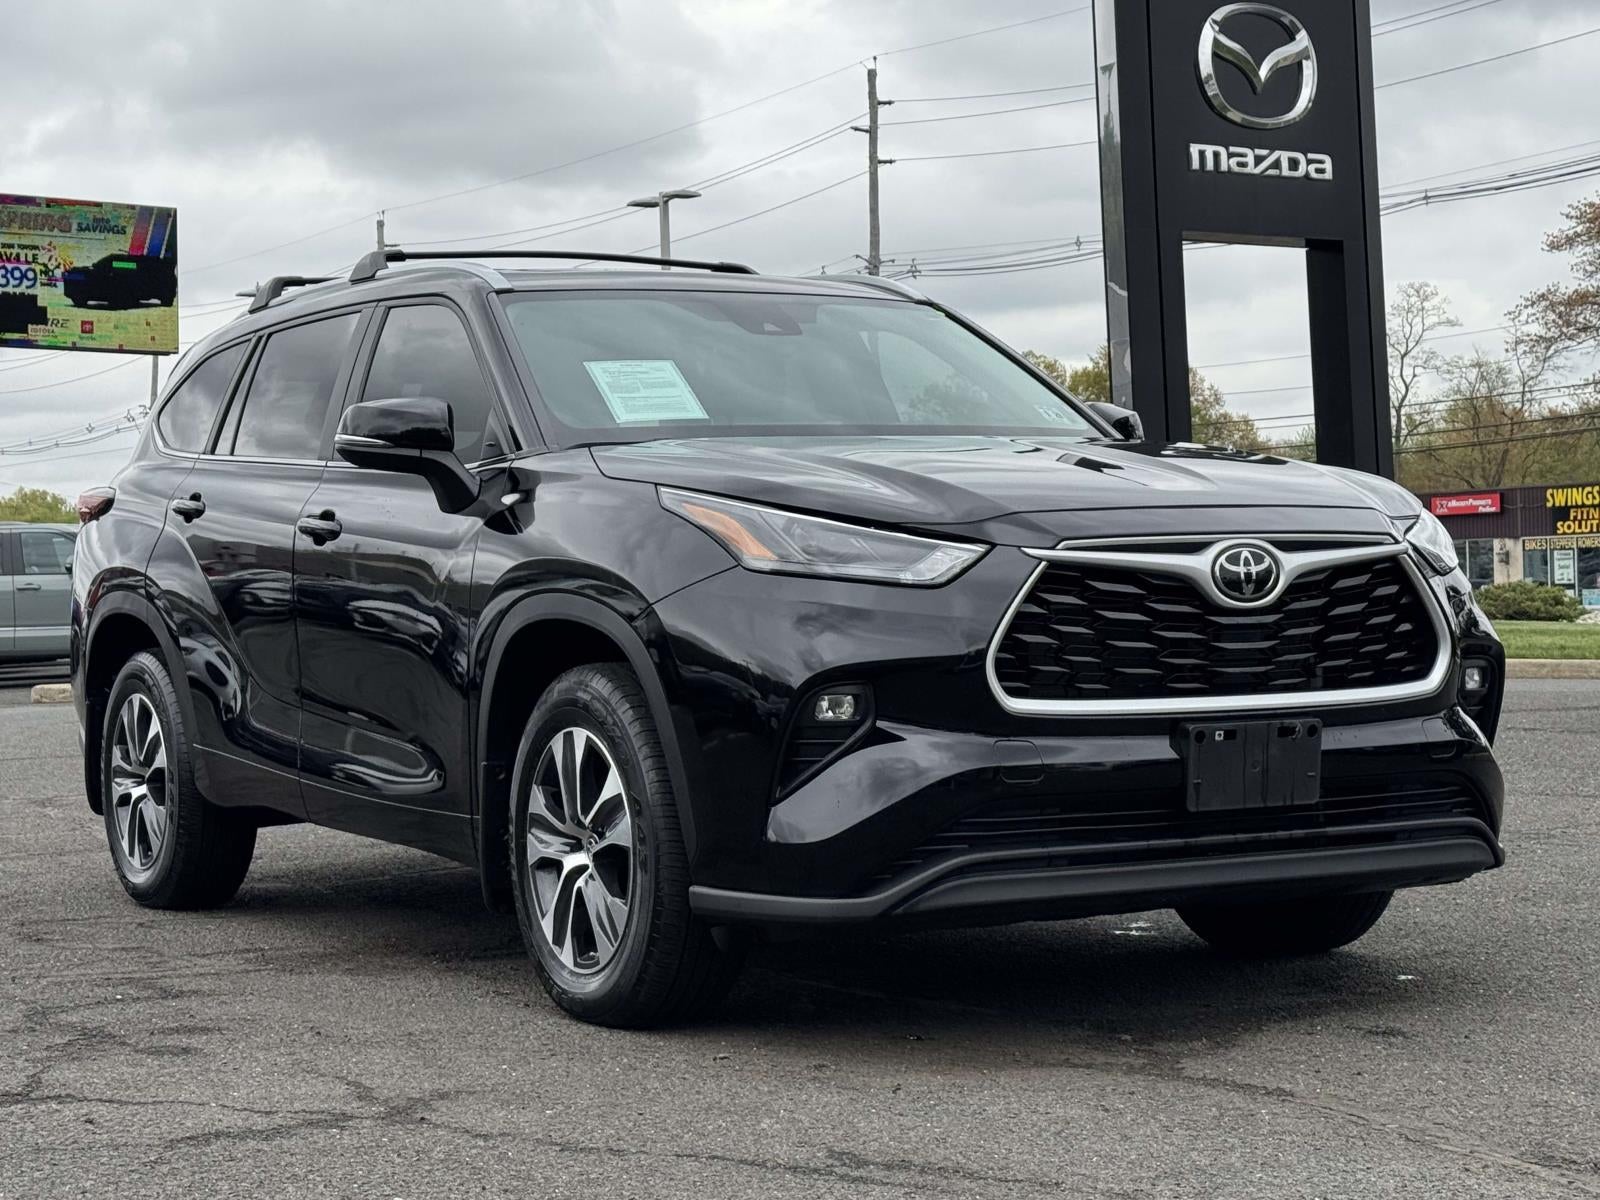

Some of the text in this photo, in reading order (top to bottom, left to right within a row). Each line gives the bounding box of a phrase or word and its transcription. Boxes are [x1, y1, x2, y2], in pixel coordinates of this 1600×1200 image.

[1189, 143, 1333, 180] mazda
[77, 223, 127, 235] SAVINGS
[25, 252, 39, 264] LE
[1546, 486, 1600, 507] SWINGS
[1570, 507, 1600, 520] FITN
[1556, 520, 1599, 533] SOLUT
[1524, 539, 1547, 550] BIKES
